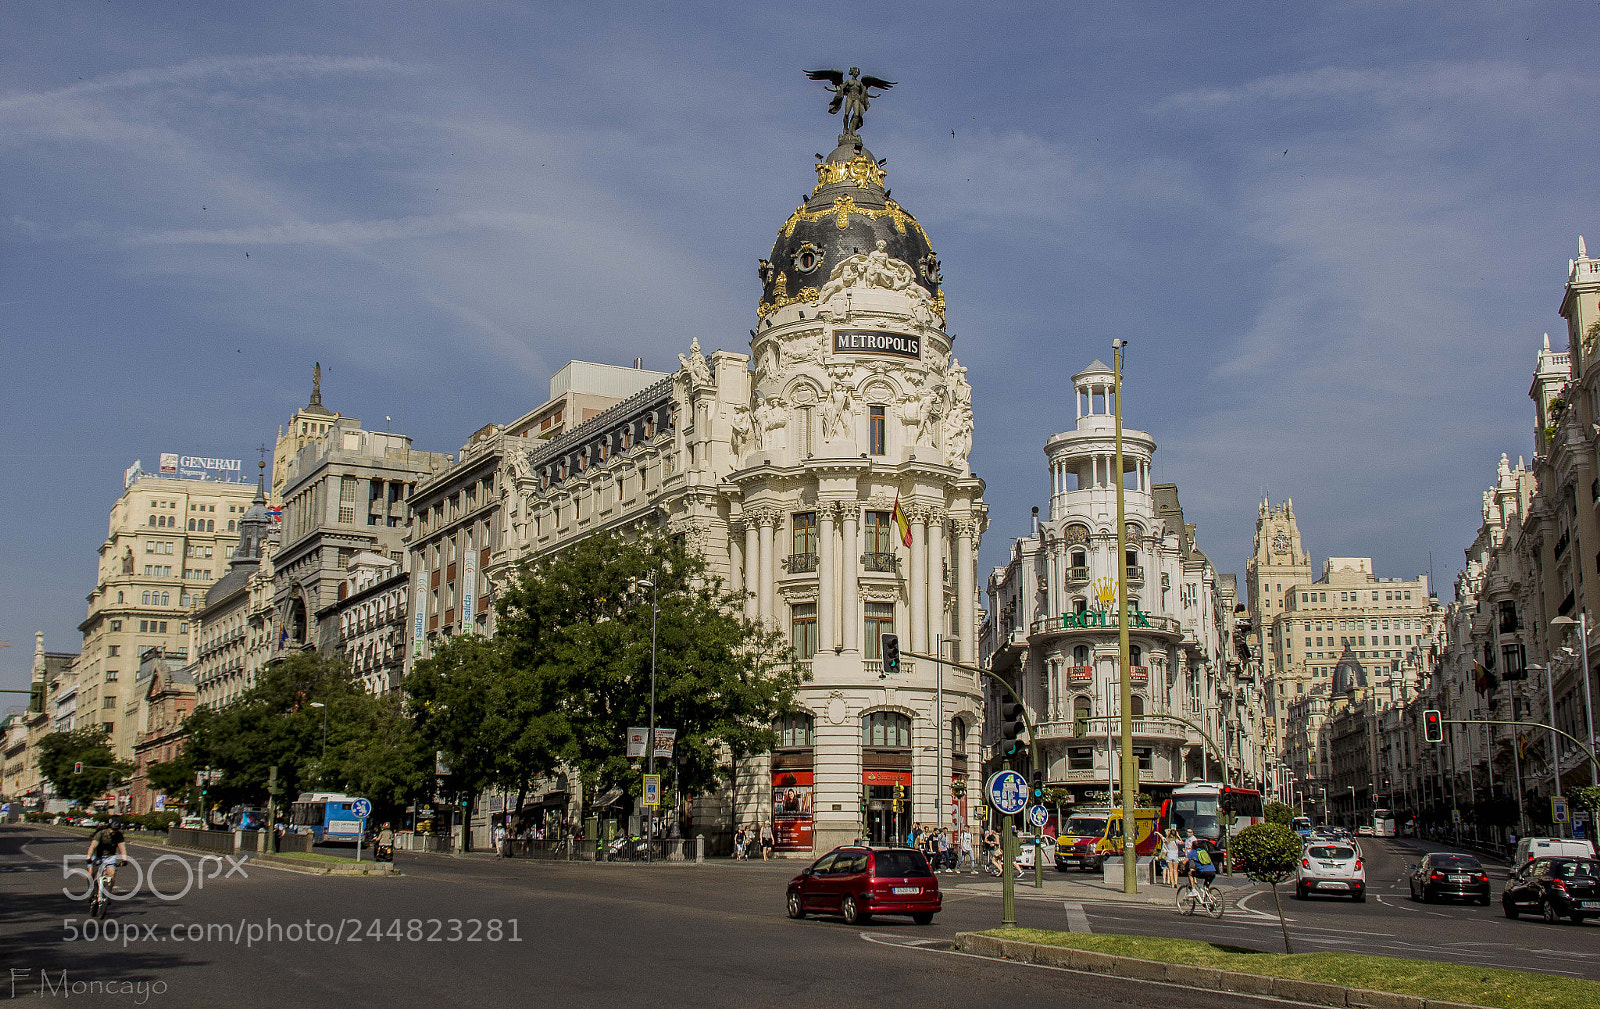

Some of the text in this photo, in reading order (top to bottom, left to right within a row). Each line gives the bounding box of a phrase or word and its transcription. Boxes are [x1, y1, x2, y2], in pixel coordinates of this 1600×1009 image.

[838, 335, 918, 353] METROPOLIS
[180, 455, 242, 470] GENERALI
[463, 594, 471, 621] salida
[414, 613, 423, 638] salida
